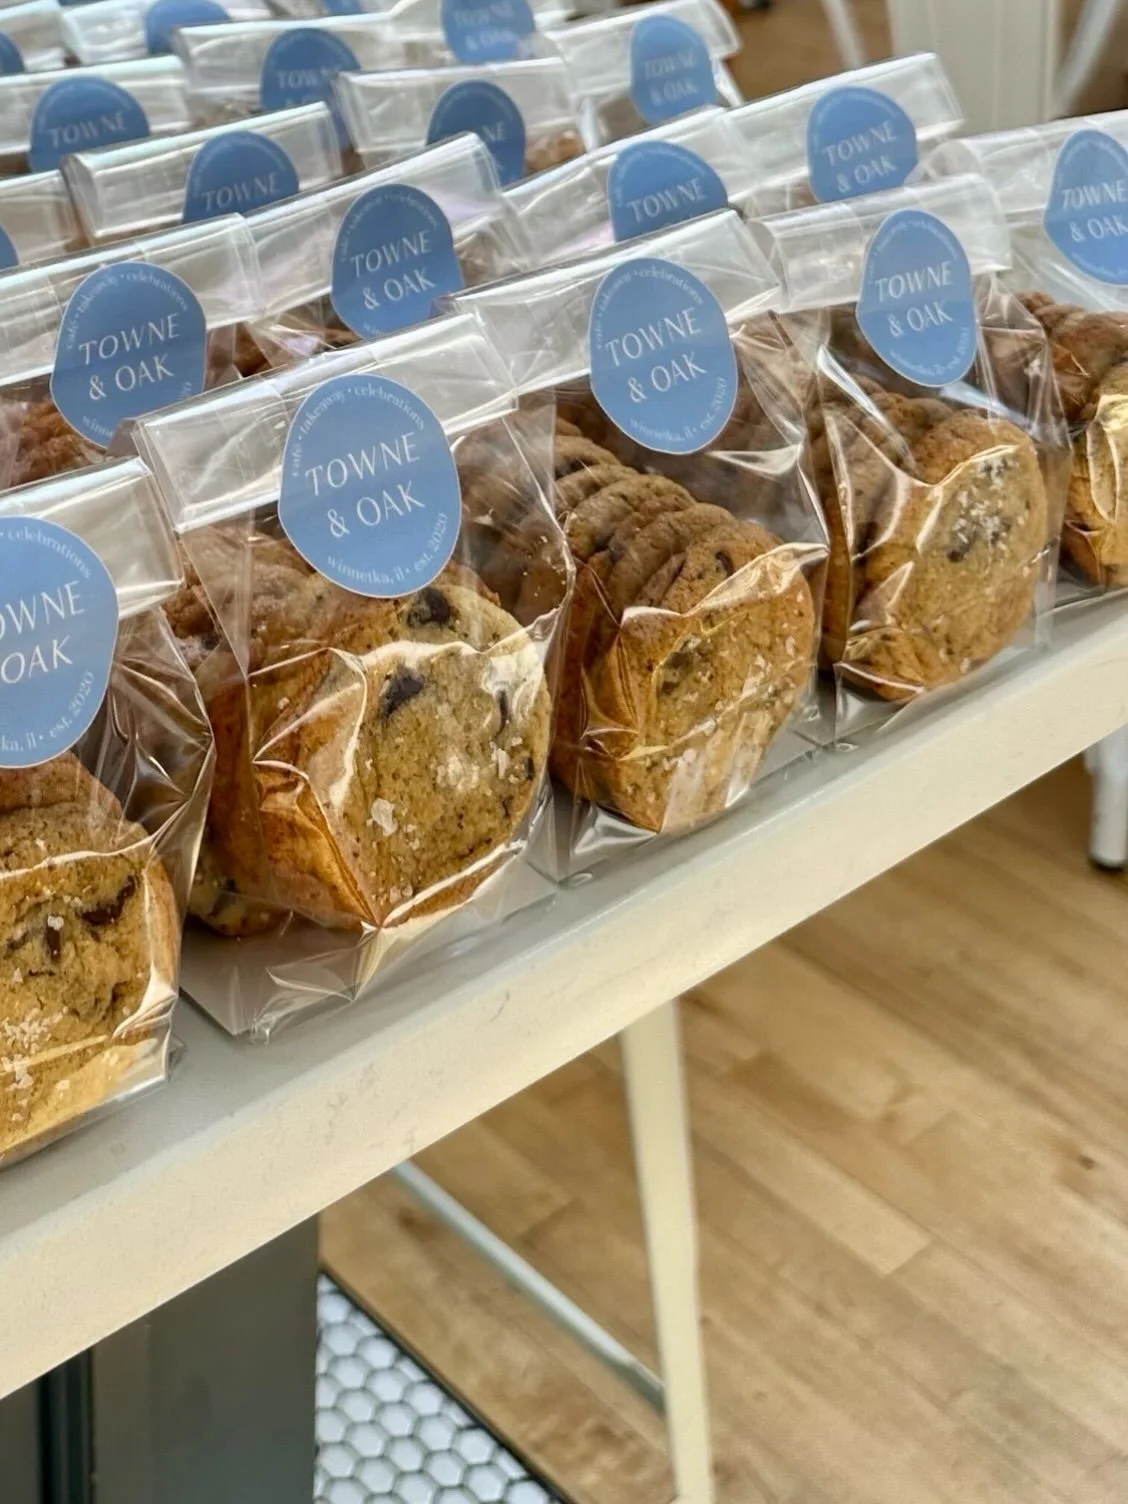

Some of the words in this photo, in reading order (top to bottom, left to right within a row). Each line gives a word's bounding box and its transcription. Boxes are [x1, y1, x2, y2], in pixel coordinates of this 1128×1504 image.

[45, 110, 128, 149] TOWNE
[822, 120, 897, 166] TOWNE
[202, 171, 281, 212] TOWNE
[836, 172, 852, 193] &
[854, 156, 899, 186] OAK
[627, 176, 708, 223] TOWNE
[350, 230, 432, 278] TOWNE
[362, 287, 381, 311] &
[384, 267, 437, 302] OAK
[874, 260, 953, 303] TOWNE
[78, 312, 181, 366] TOWNE
[605, 307, 703, 367] TOWNE
[887, 313, 905, 338] &
[906, 301, 953, 332] OAK
[89, 375, 107, 401] &
[115, 352, 175, 392] OAK
[627, 376, 647, 403] &
[651, 351, 708, 393] OAK
[304, 431, 421, 497] TOWNE
[327, 508, 351, 539] &
[356, 479, 426, 527] OAK
[8, 525, 93, 581] celebrations
[0, 634, 74, 685] OAK
[68, 671, 96, 719] 2020
